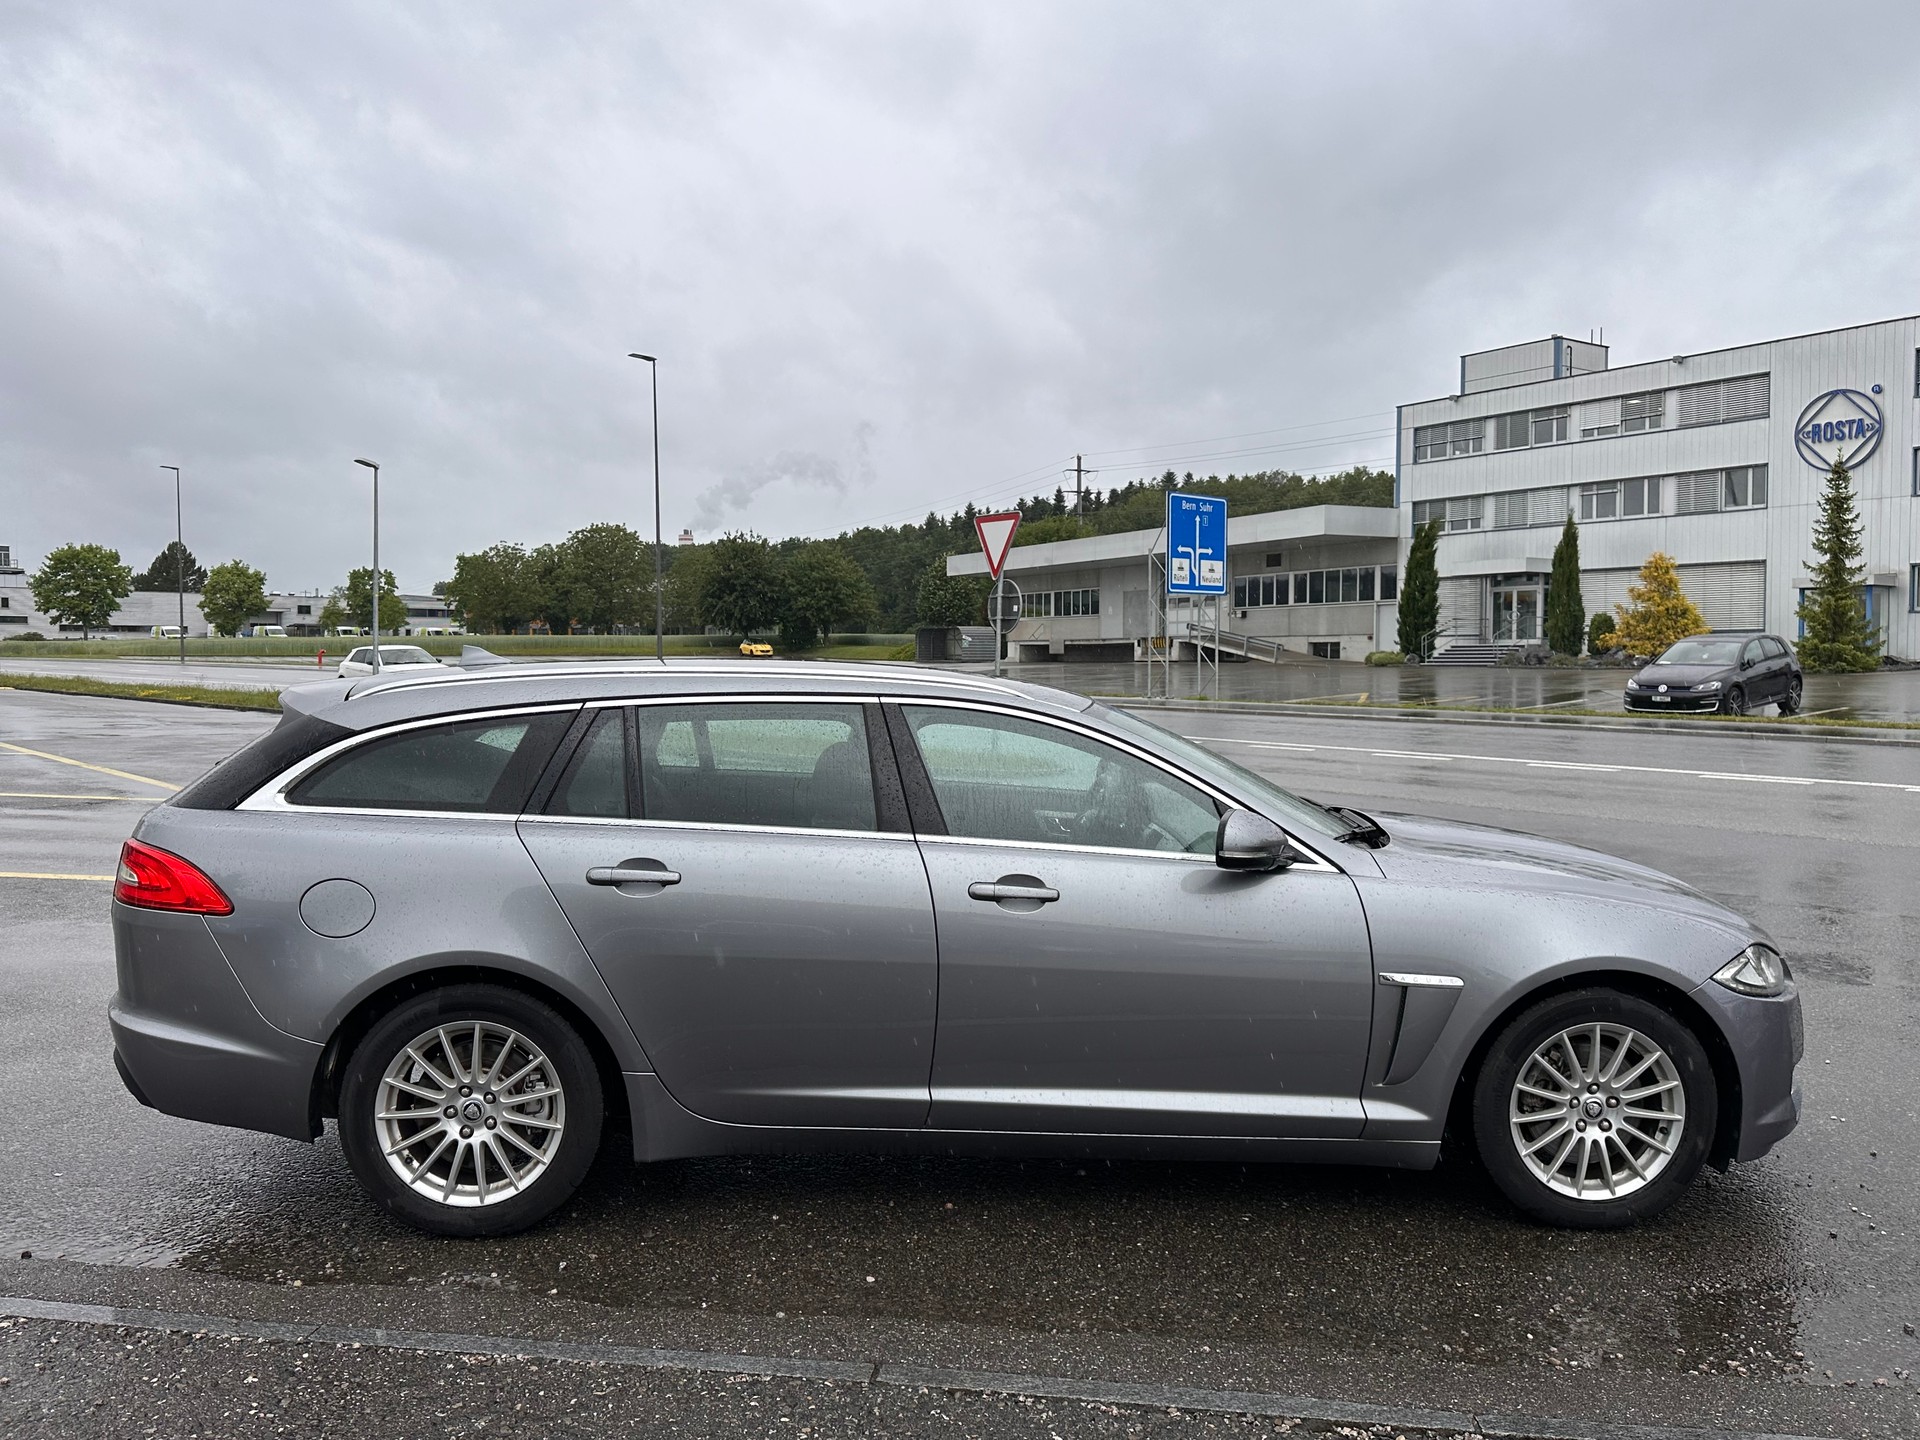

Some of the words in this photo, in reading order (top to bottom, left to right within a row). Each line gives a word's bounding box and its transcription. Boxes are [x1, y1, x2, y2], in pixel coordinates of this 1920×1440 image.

[1181, 500, 1197, 510] Bern
[1199, 502, 1214, 513] Suhr
[1202, 575, 1222, 585] Neuland
[1389, 974, 1457, 985] AGUAR
